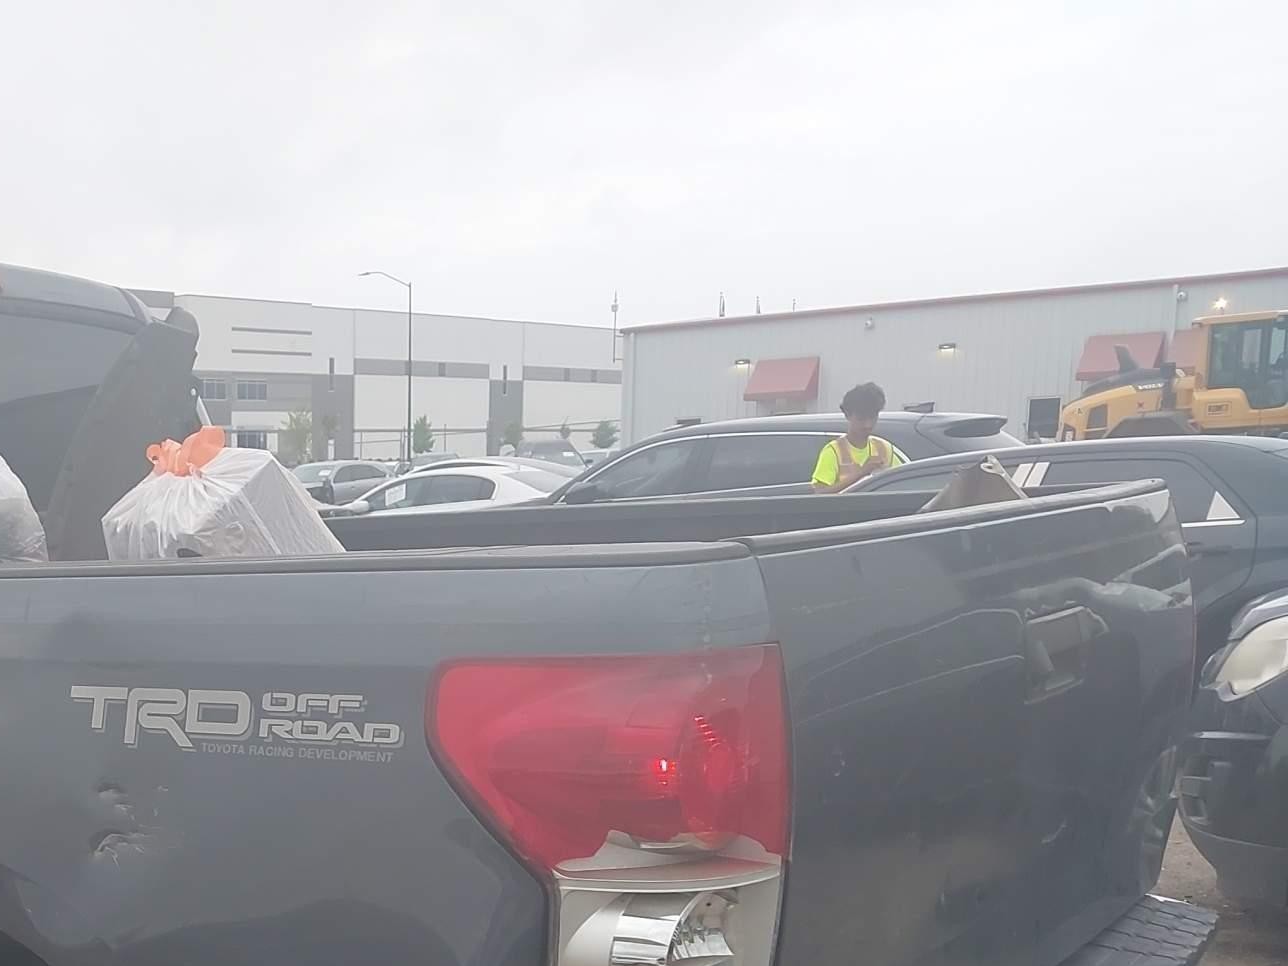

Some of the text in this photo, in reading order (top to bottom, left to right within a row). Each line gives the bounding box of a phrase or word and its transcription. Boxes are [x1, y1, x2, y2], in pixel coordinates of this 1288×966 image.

[1137, 383, 1165, 391] VOLV
[262, 692, 366, 717] OFF
[70, 685, 254, 750] TRD
[259, 718, 404, 748] ROAD
[201, 742, 394, 763] TOYOTA RACING DEVELOPMENT
